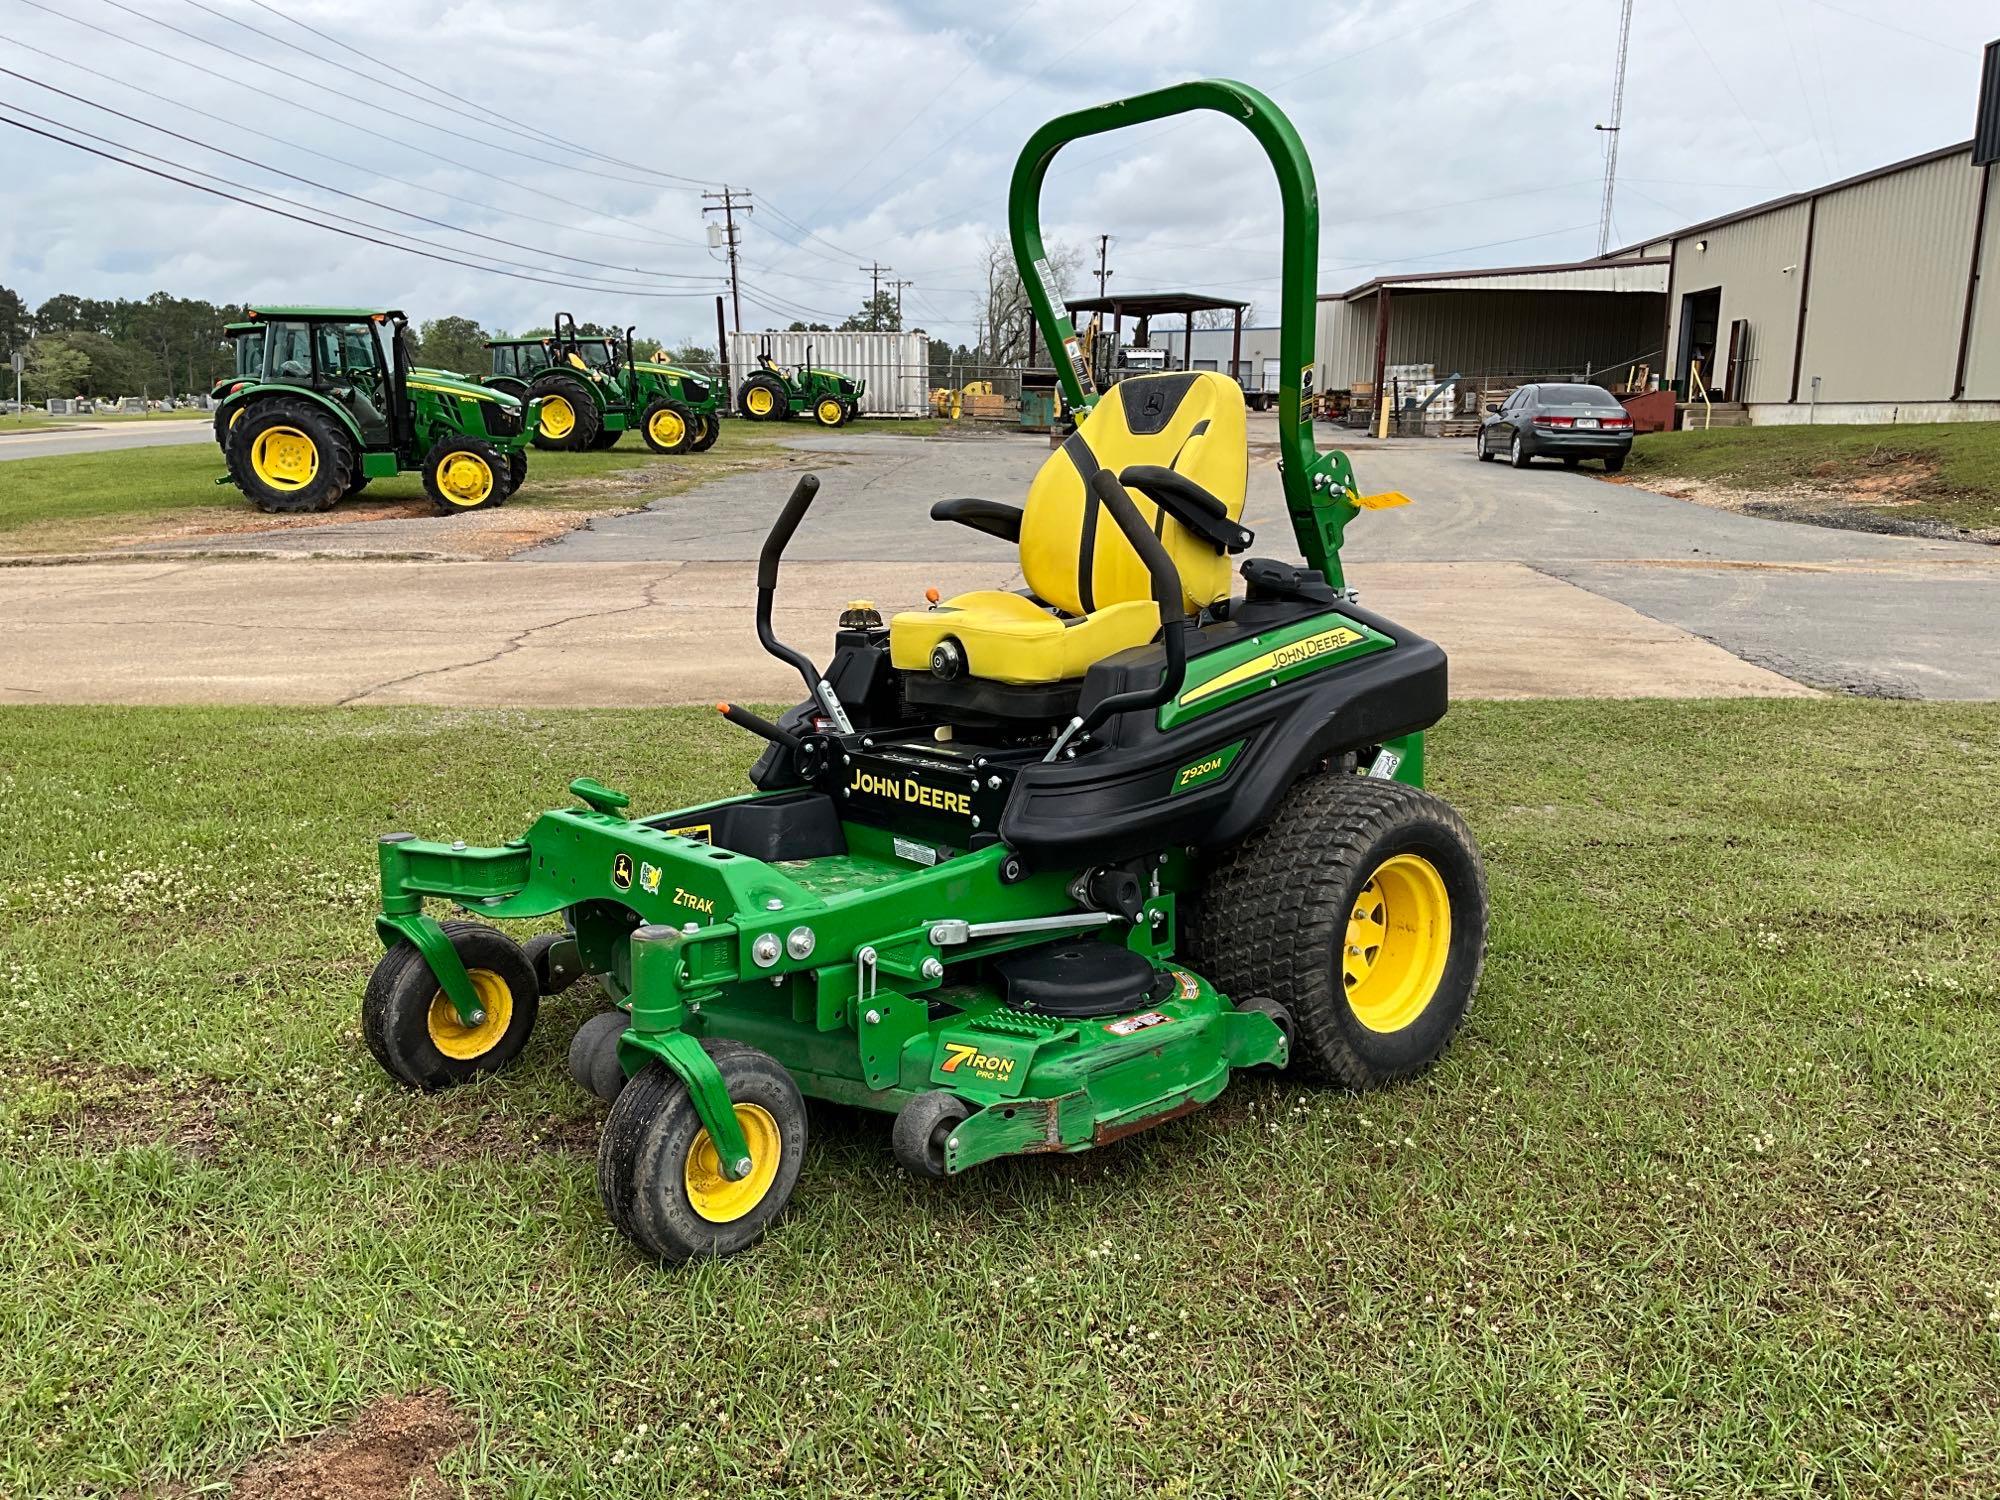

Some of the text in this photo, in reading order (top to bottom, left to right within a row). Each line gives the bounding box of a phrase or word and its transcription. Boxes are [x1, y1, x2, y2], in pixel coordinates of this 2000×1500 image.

[1271, 632, 1348, 668] JOHN DEERE
[1180, 757, 1222, 785] Z920M
[850, 768, 971, 815] JOHN DEERE
[672, 887, 714, 914] ZTRAK
[975, 1070, 1009, 1082] PRO 54
